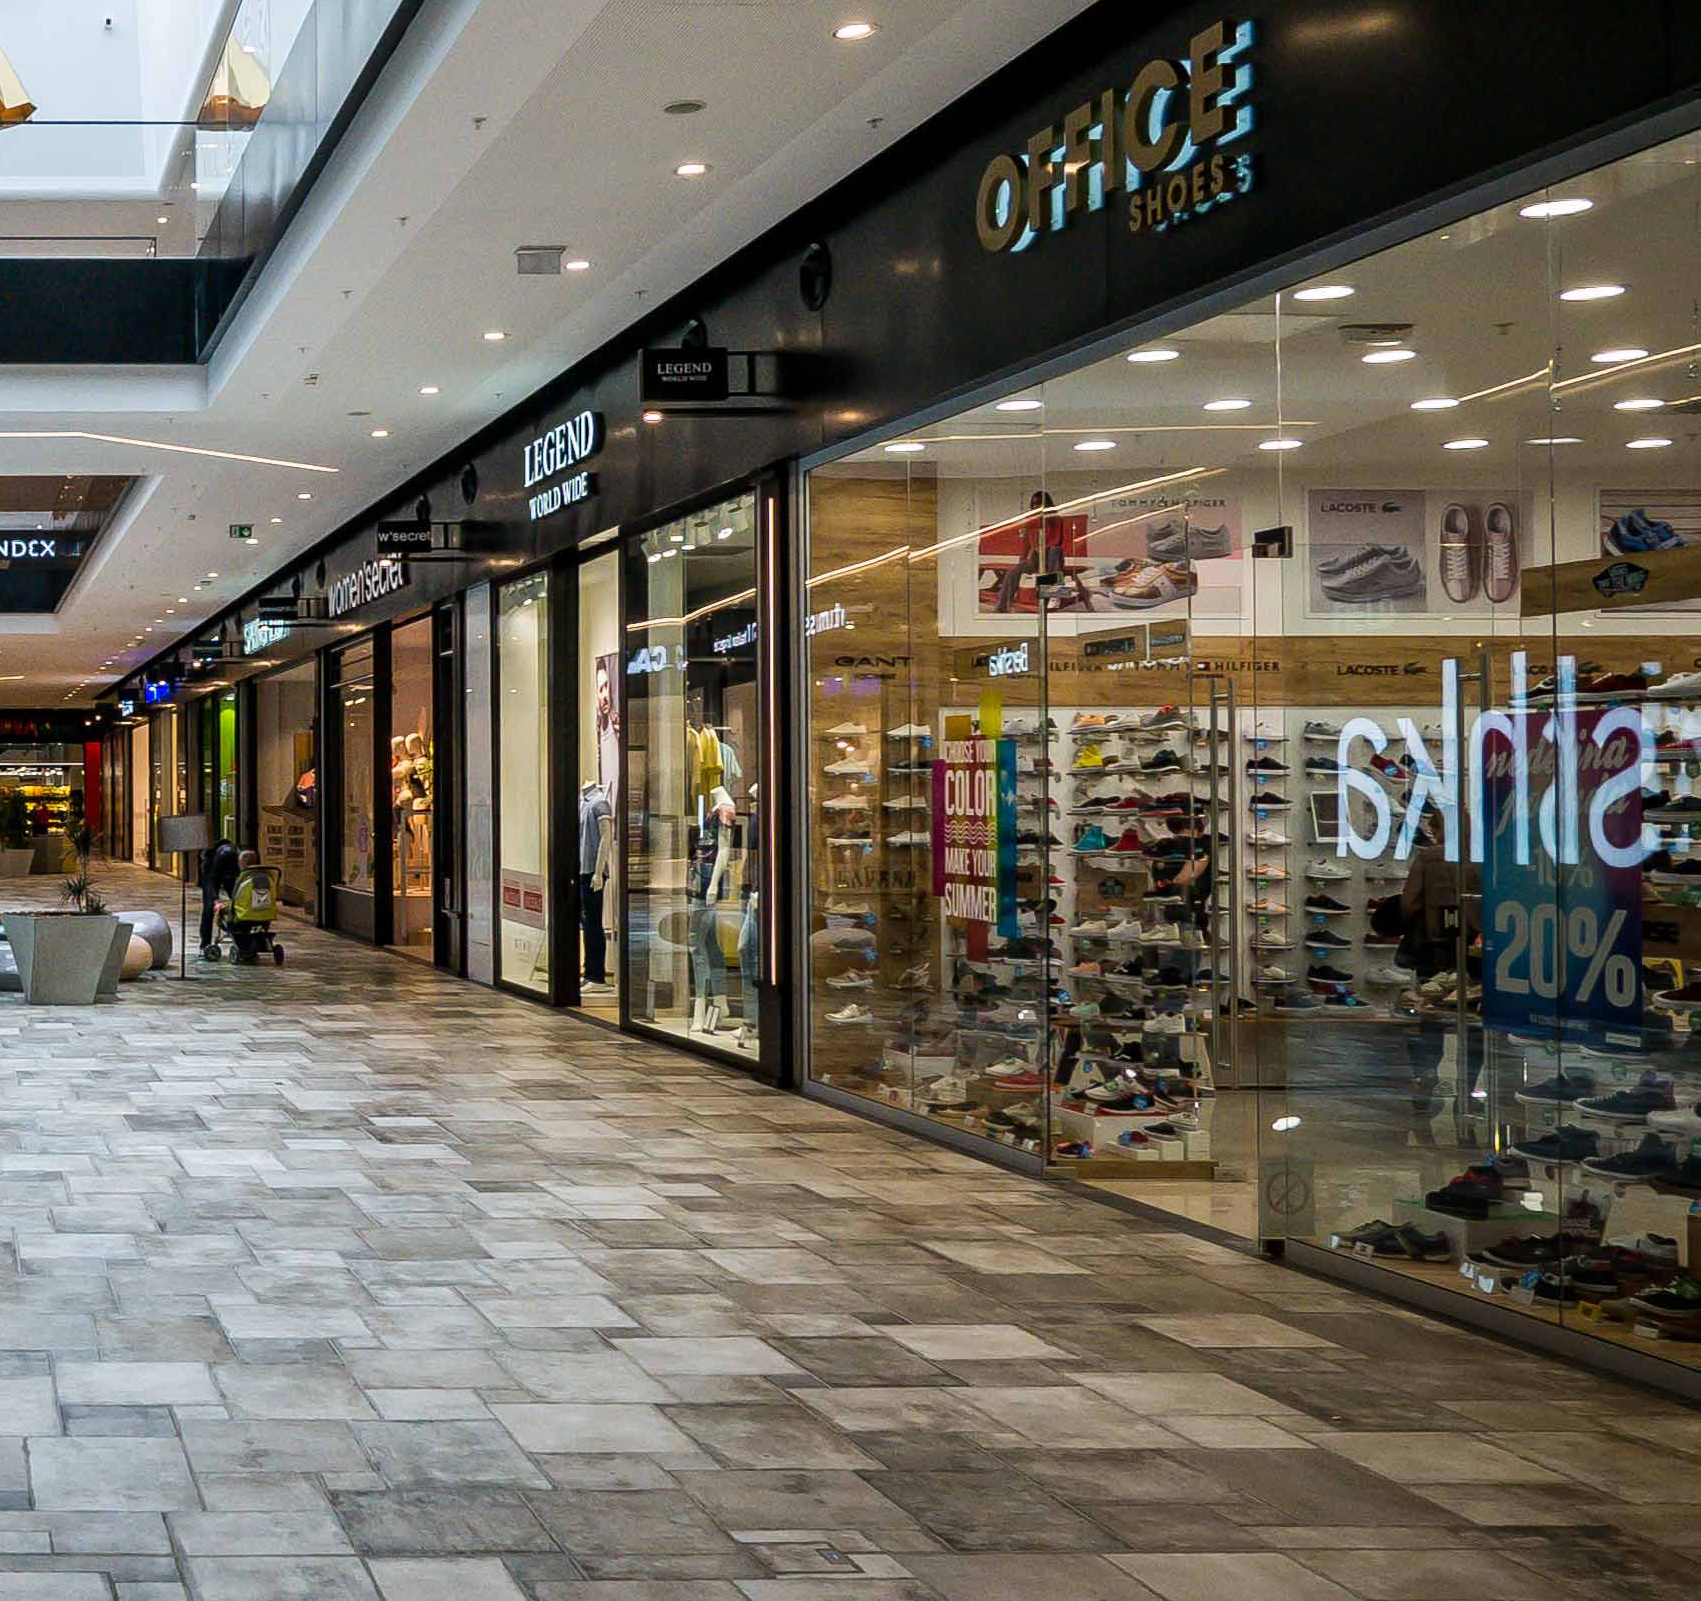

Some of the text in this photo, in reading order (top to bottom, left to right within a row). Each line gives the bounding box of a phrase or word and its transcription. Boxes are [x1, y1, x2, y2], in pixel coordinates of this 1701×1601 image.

[976, 20, 1252, 251] OFFICE
[1129, 154, 1238, 233] SHOES
[656, 362, 712, 375] LEGEND
[523, 410, 595, 488] LEGEND
[529, 471, 588, 521] WORLD WIDE
[1321, 502, 1378, 513] LACOSTE
[835, 656, 914, 667] GANT
[1214, 661, 1280, 672] HILFIGER
[1337, 664, 1399, 676] LACOSTE
[945, 770, 997, 817] COLOR
[945, 846, 997, 878] MAKE YOUR
[945, 883, 998, 924] SUMMER
[1495, 901, 1636, 1008] 20%
